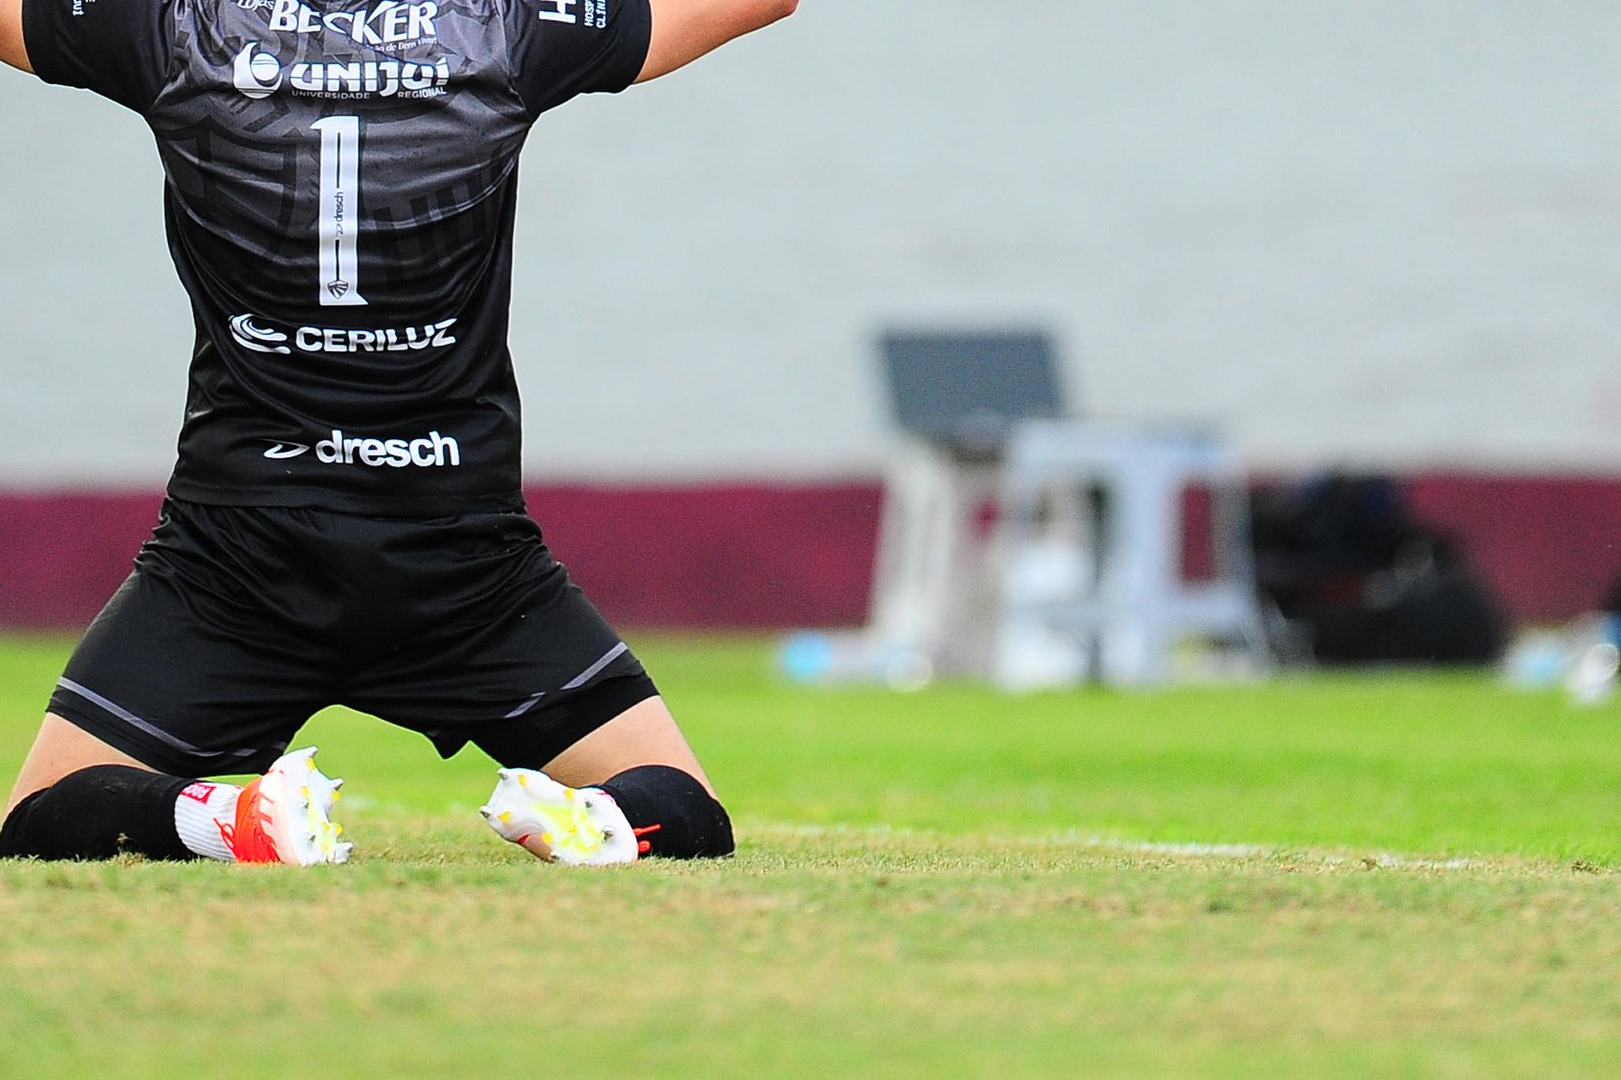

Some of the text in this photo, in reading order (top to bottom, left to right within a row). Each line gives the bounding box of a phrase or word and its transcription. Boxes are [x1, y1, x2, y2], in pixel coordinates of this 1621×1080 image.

[291, 87, 447, 100] UNIVERSIDADE REGIONAL
[309, 115, 369, 306] 1
[333, 191, 344, 222] dresch
[295, 318, 458, 352] CERILUZ
[315, 430, 461, 467] dresch
